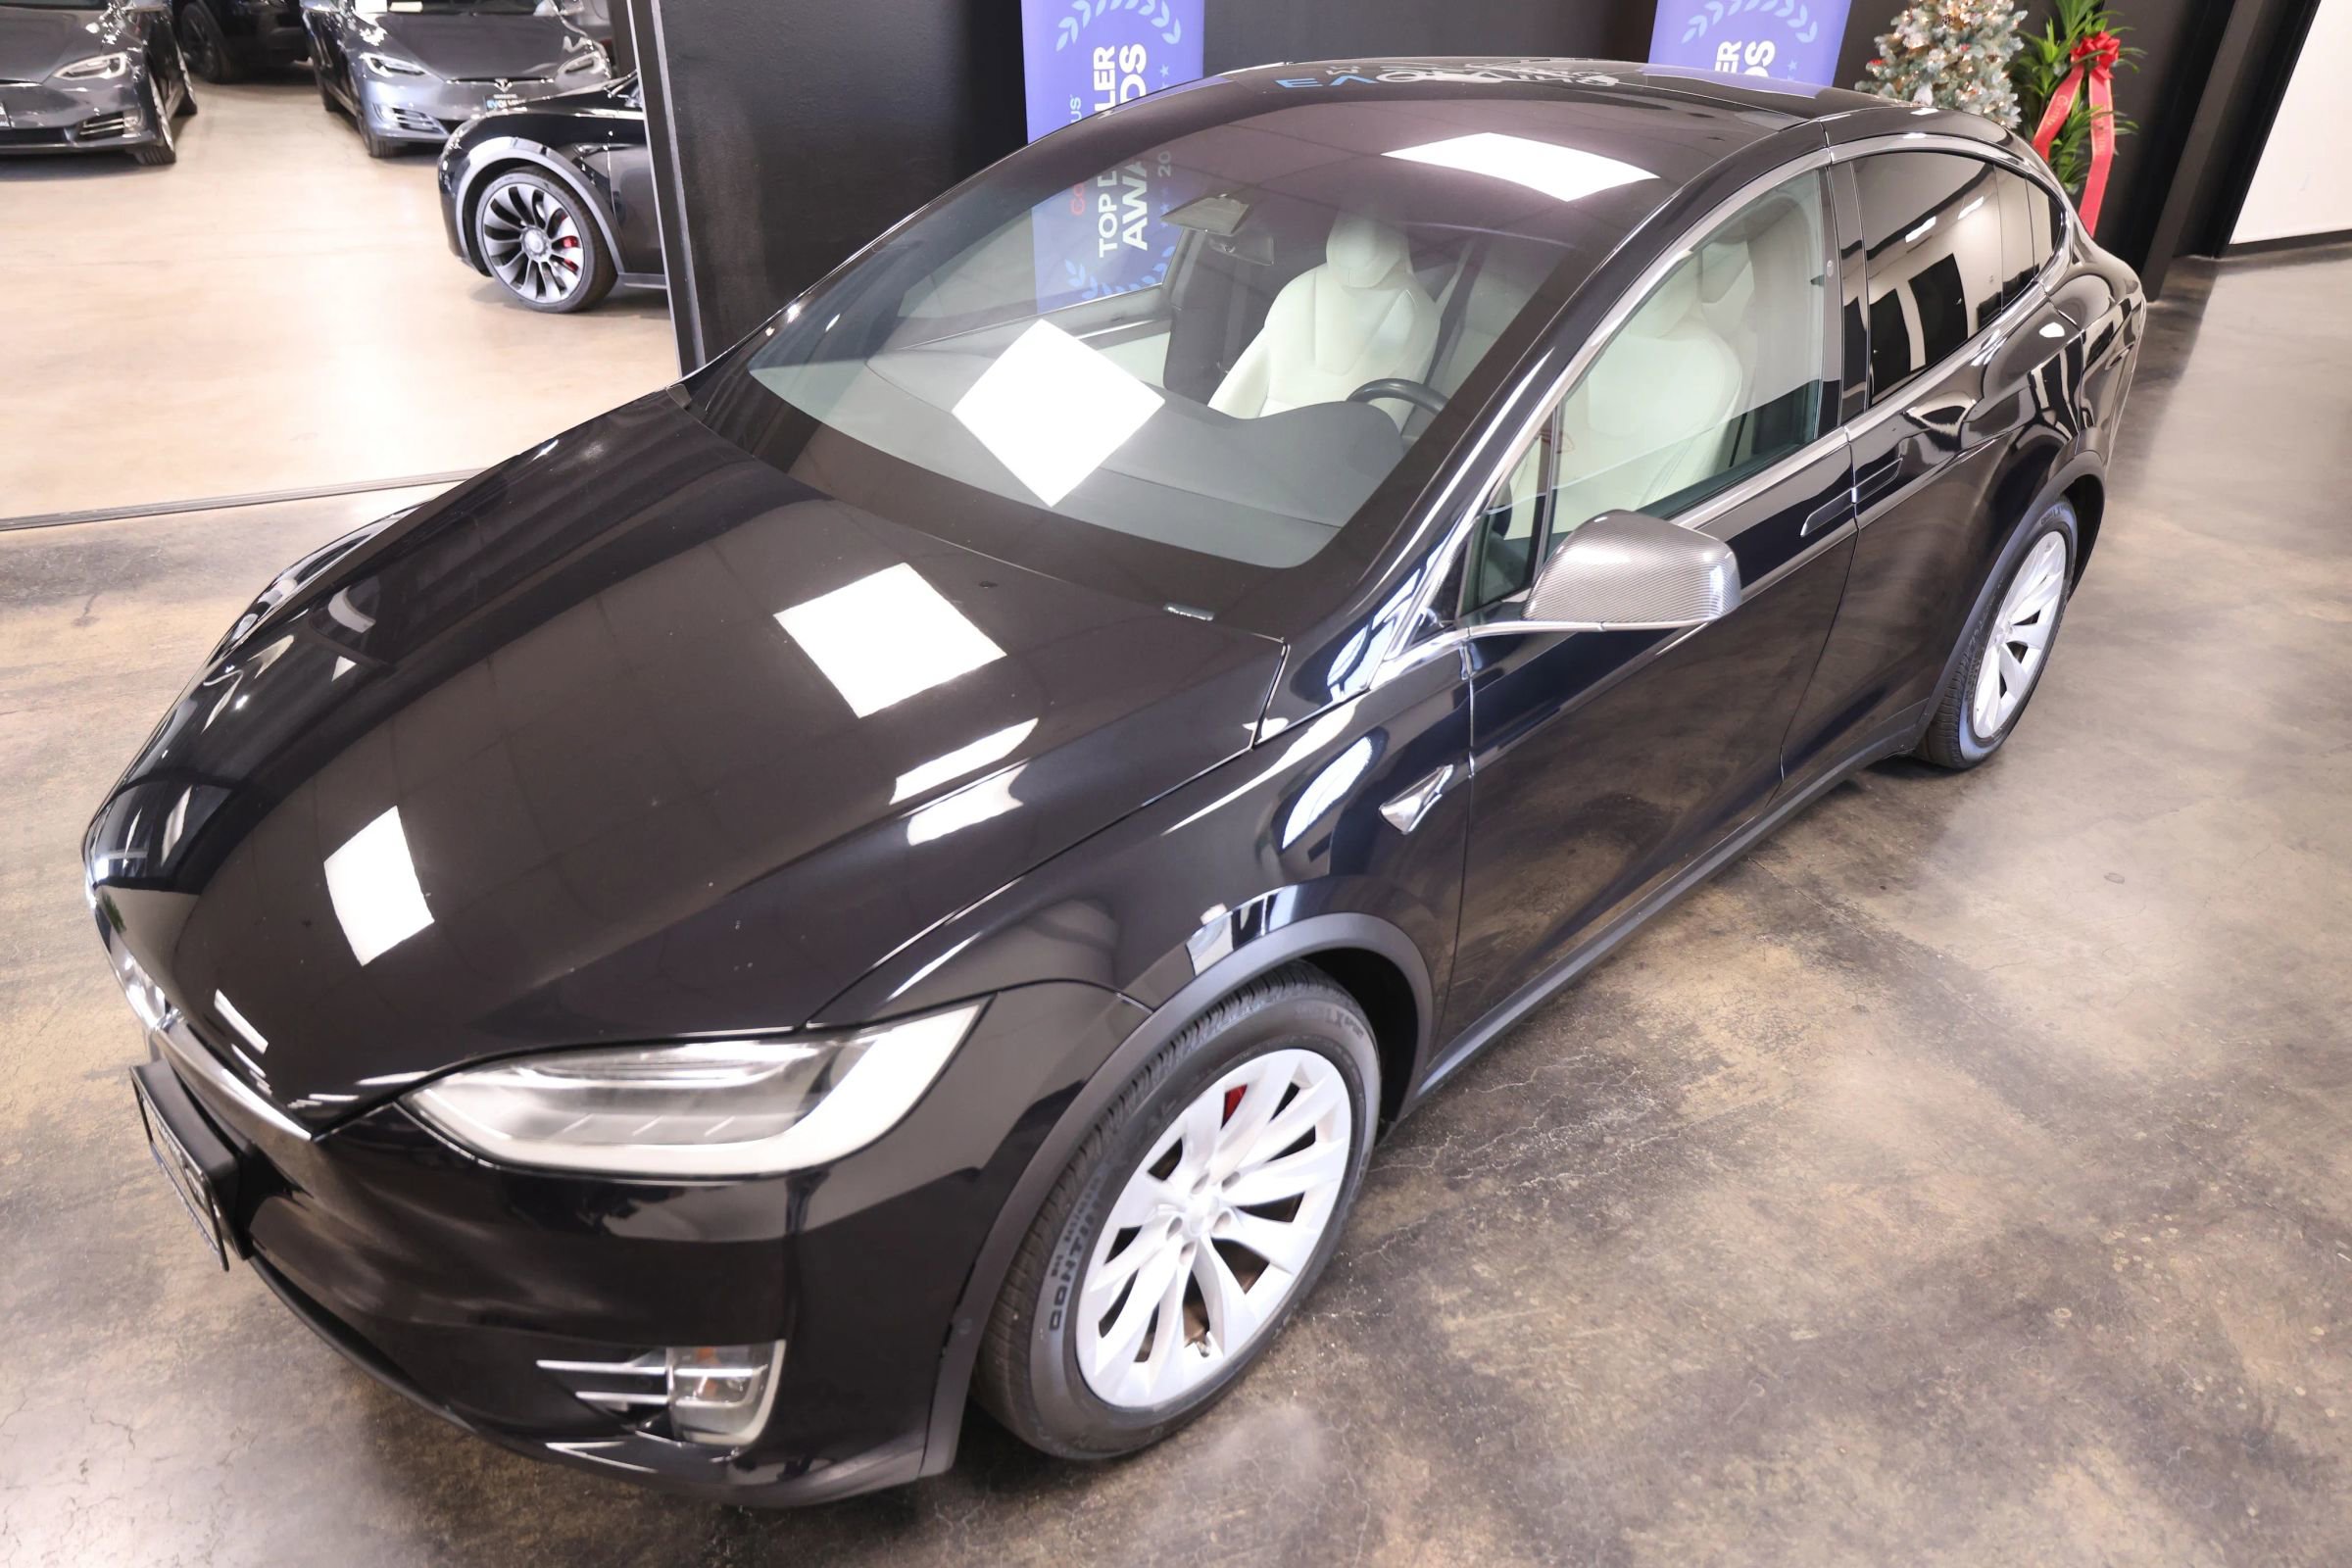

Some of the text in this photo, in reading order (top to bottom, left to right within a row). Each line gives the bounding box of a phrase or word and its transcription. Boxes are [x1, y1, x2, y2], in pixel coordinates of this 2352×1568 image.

[1093, 45, 1117, 258] TOP DLER
[1119, 43, 1148, 251] AWADS
